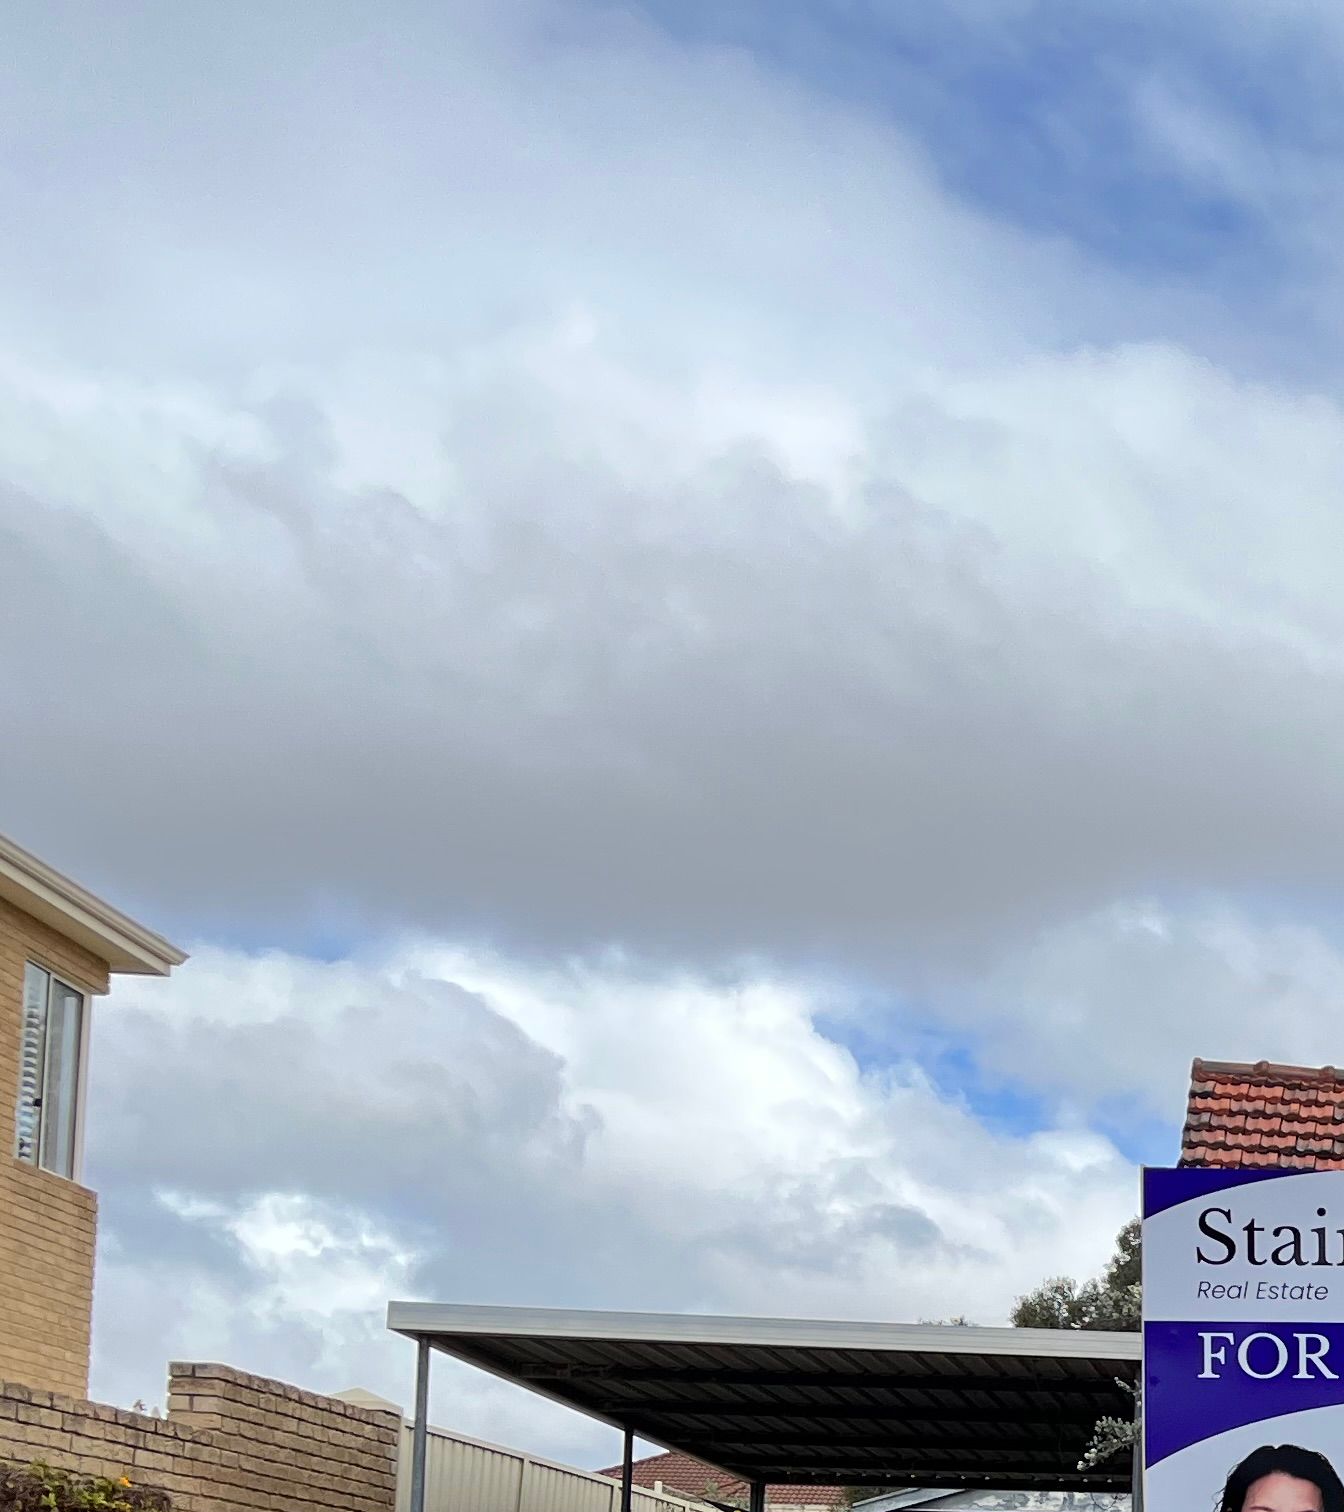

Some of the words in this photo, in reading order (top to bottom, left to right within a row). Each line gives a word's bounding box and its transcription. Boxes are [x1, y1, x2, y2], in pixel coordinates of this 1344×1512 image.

[1198, 1281, 1248, 1299] Real
[1256, 1282, 1328, 1300] Estate
[1198, 1332, 1339, 1379] FOR
